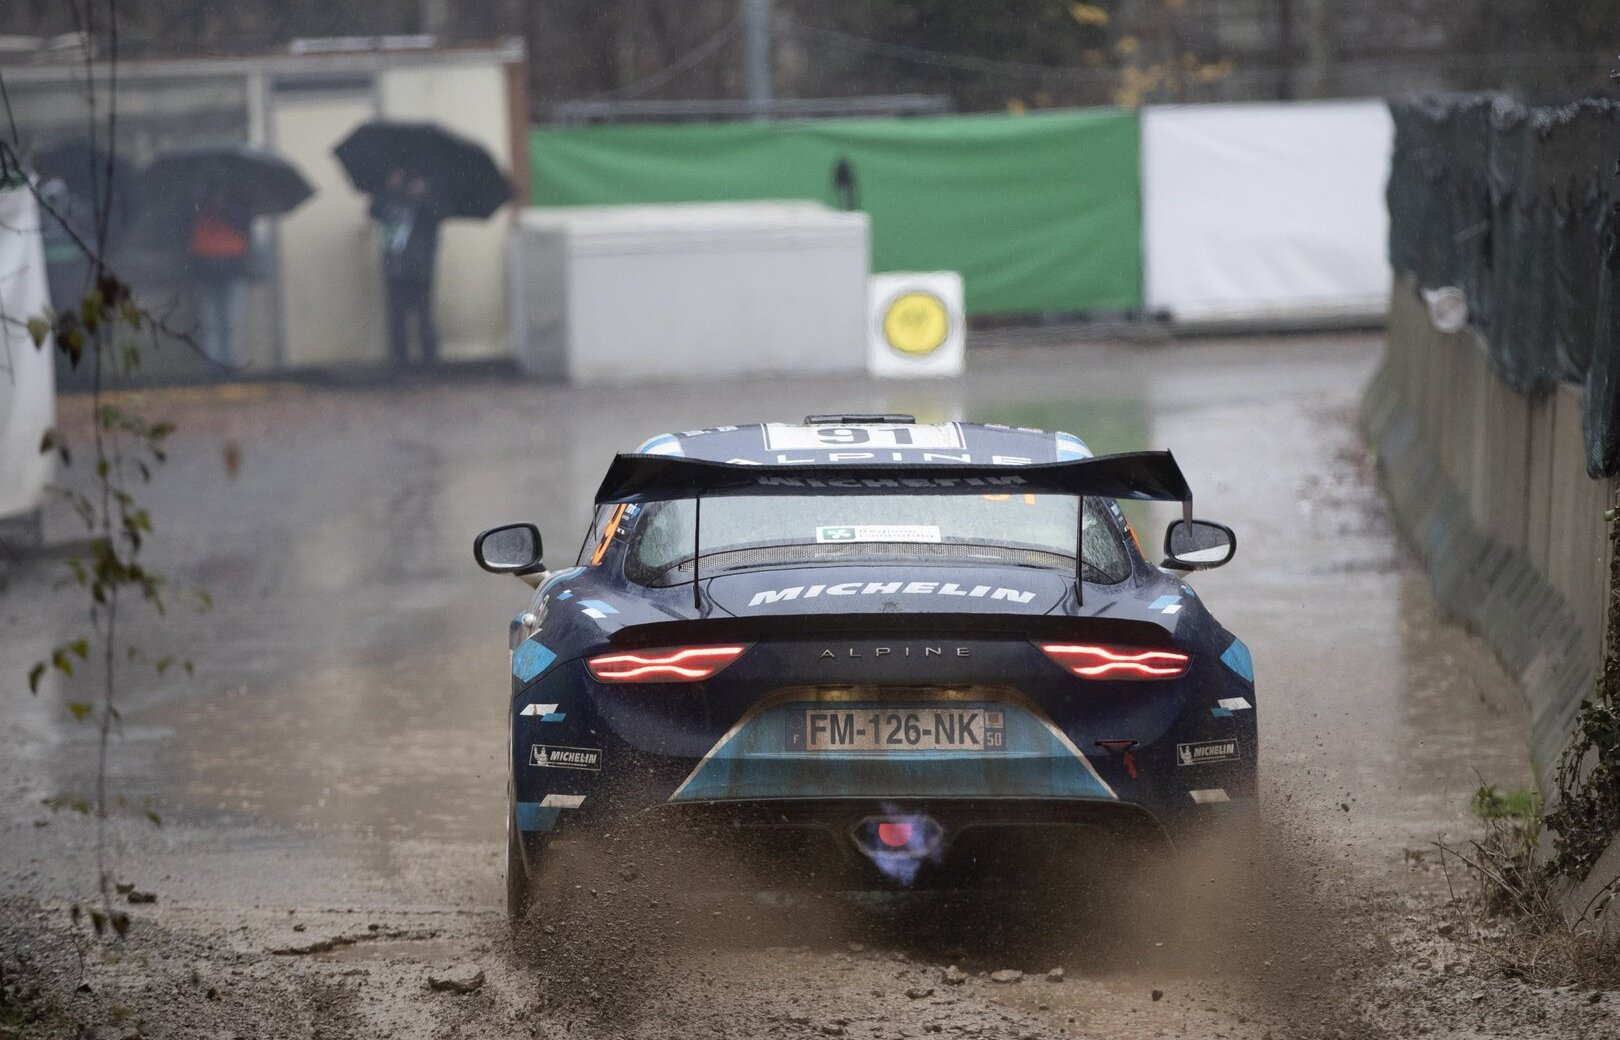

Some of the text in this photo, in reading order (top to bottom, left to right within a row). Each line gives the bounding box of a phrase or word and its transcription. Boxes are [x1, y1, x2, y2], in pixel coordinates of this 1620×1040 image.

[816, 428, 914, 445] 91
[748, 581, 1037, 606] MICHELIN
[819, 646, 971, 658] ALPINE
[793, 712, 1002, 747] F FM-126-NK 50
[550, 750, 597, 764] MICHELIN
[1194, 743, 1235, 757] MICHELIN
